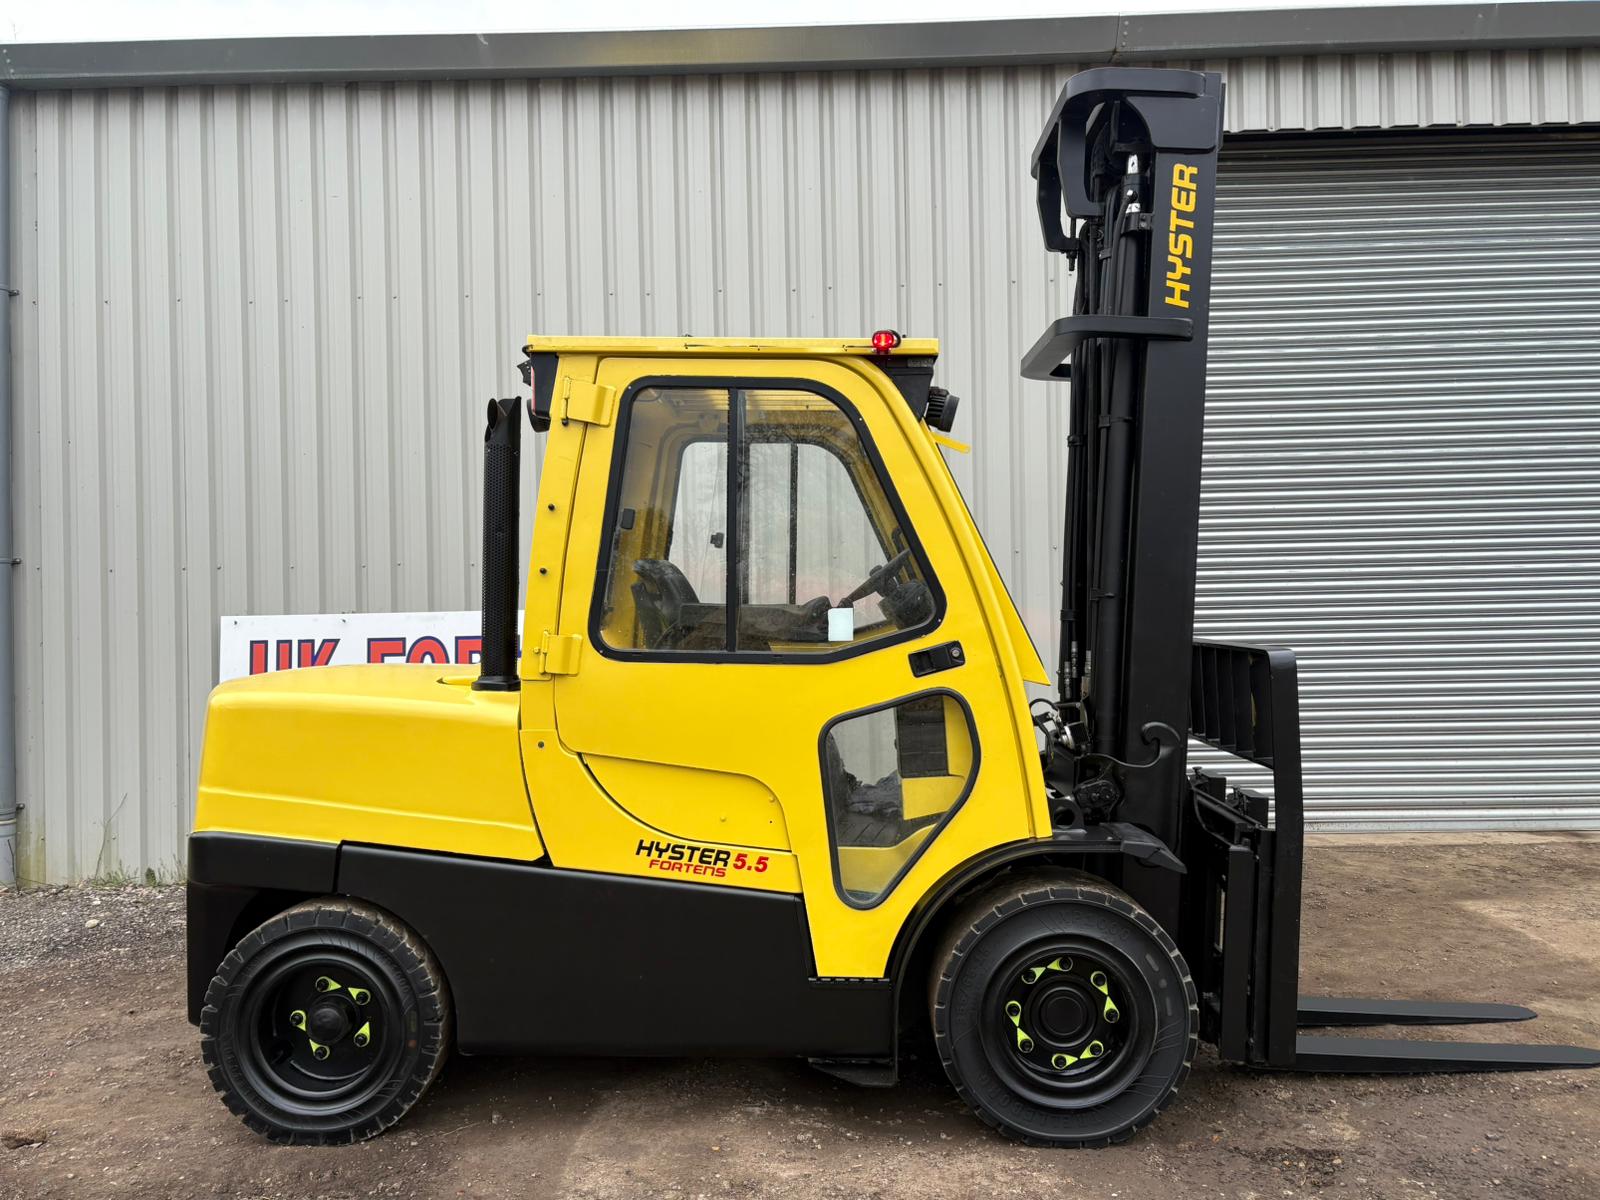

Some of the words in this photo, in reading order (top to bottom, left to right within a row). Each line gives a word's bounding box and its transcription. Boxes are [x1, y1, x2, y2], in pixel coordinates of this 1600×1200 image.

[1165, 163, 1198, 309] HYSTER
[635, 839, 731, 867] HYSTER
[733, 853, 769, 873] 5.5
[649, 859, 727, 878] FORTENS
